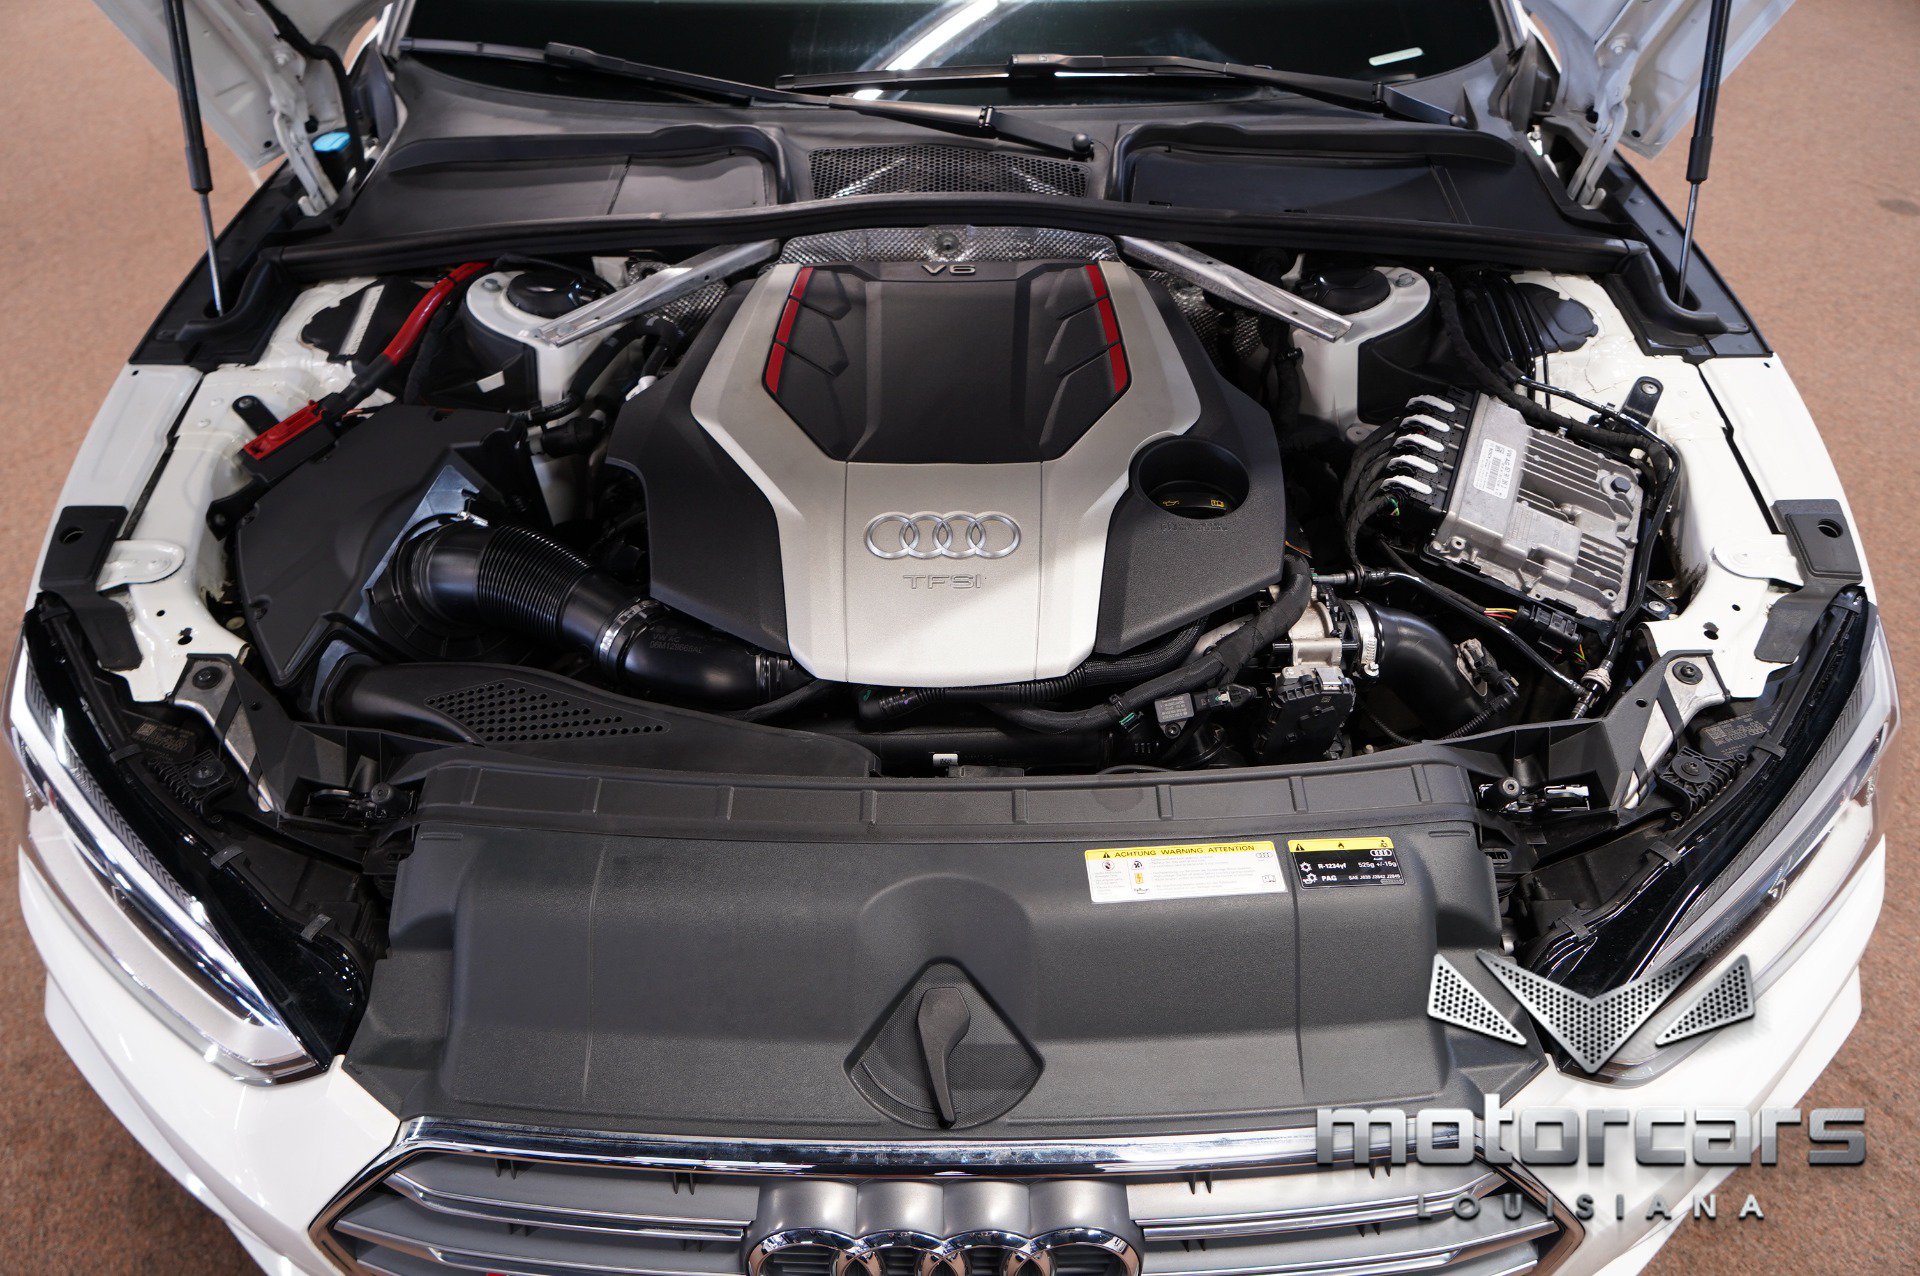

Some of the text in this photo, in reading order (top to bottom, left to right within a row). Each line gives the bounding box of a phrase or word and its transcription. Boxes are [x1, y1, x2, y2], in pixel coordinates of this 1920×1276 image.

[921, 264, 976, 276] V6
[903, 574, 981, 589] TFSI
[1114, 845, 1255, 858] ACHTUNG WARNING ATTENTION
[1317, 862, 1347, 870] R-1234yf
